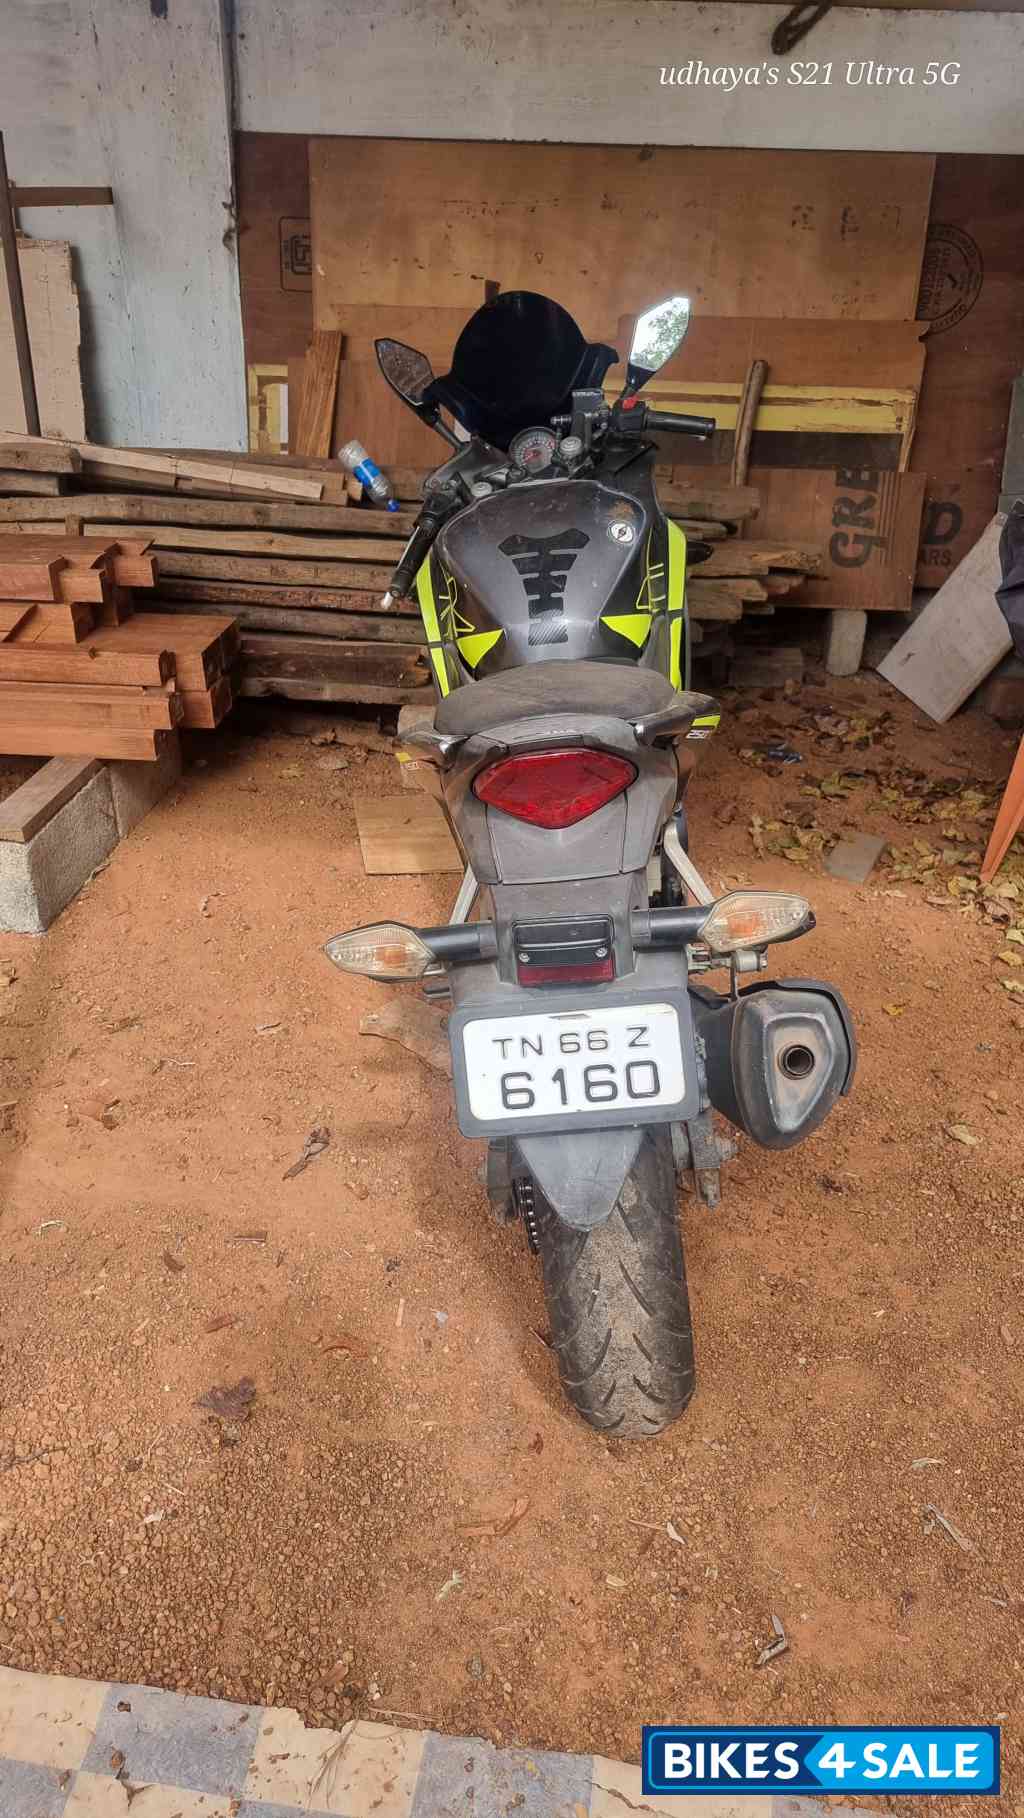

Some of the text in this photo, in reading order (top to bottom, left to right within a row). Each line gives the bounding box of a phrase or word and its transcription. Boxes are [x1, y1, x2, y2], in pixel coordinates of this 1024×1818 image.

[492, 1026, 649, 1059] TN 66 Z
[501, 1060, 661, 1110] 6160
